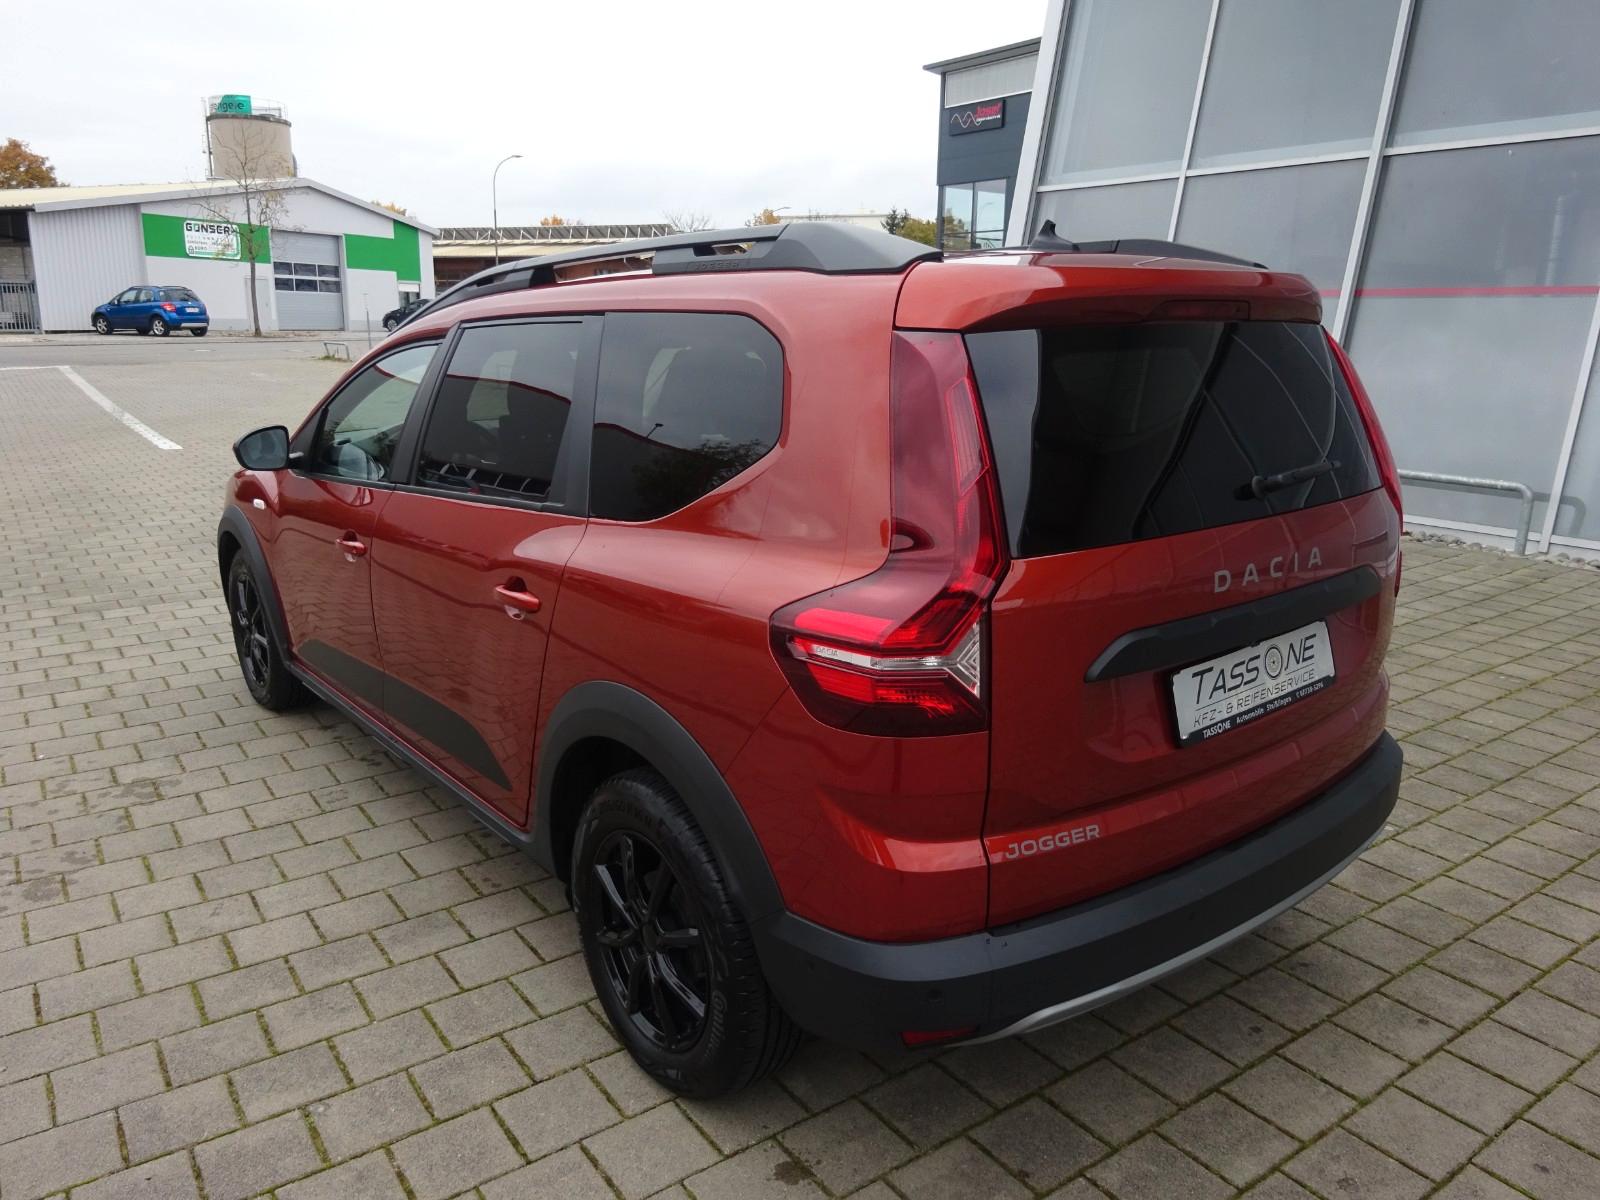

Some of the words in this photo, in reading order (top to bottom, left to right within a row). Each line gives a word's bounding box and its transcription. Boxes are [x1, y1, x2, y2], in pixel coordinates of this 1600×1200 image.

[1214, 547, 1322, 593] DACIA
[815, 646, 839, 657] DACIA
[1191, 633, 1317, 705] TASSONE
[1194, 707, 1222, 728] KFZ-
[1225, 702, 1234, 715] &
[1236, 668, 1315, 712] REIFENSERVICE
[1202, 720, 1232, 739] TASSONE
[1005, 825, 1100, 859] JOGGER
